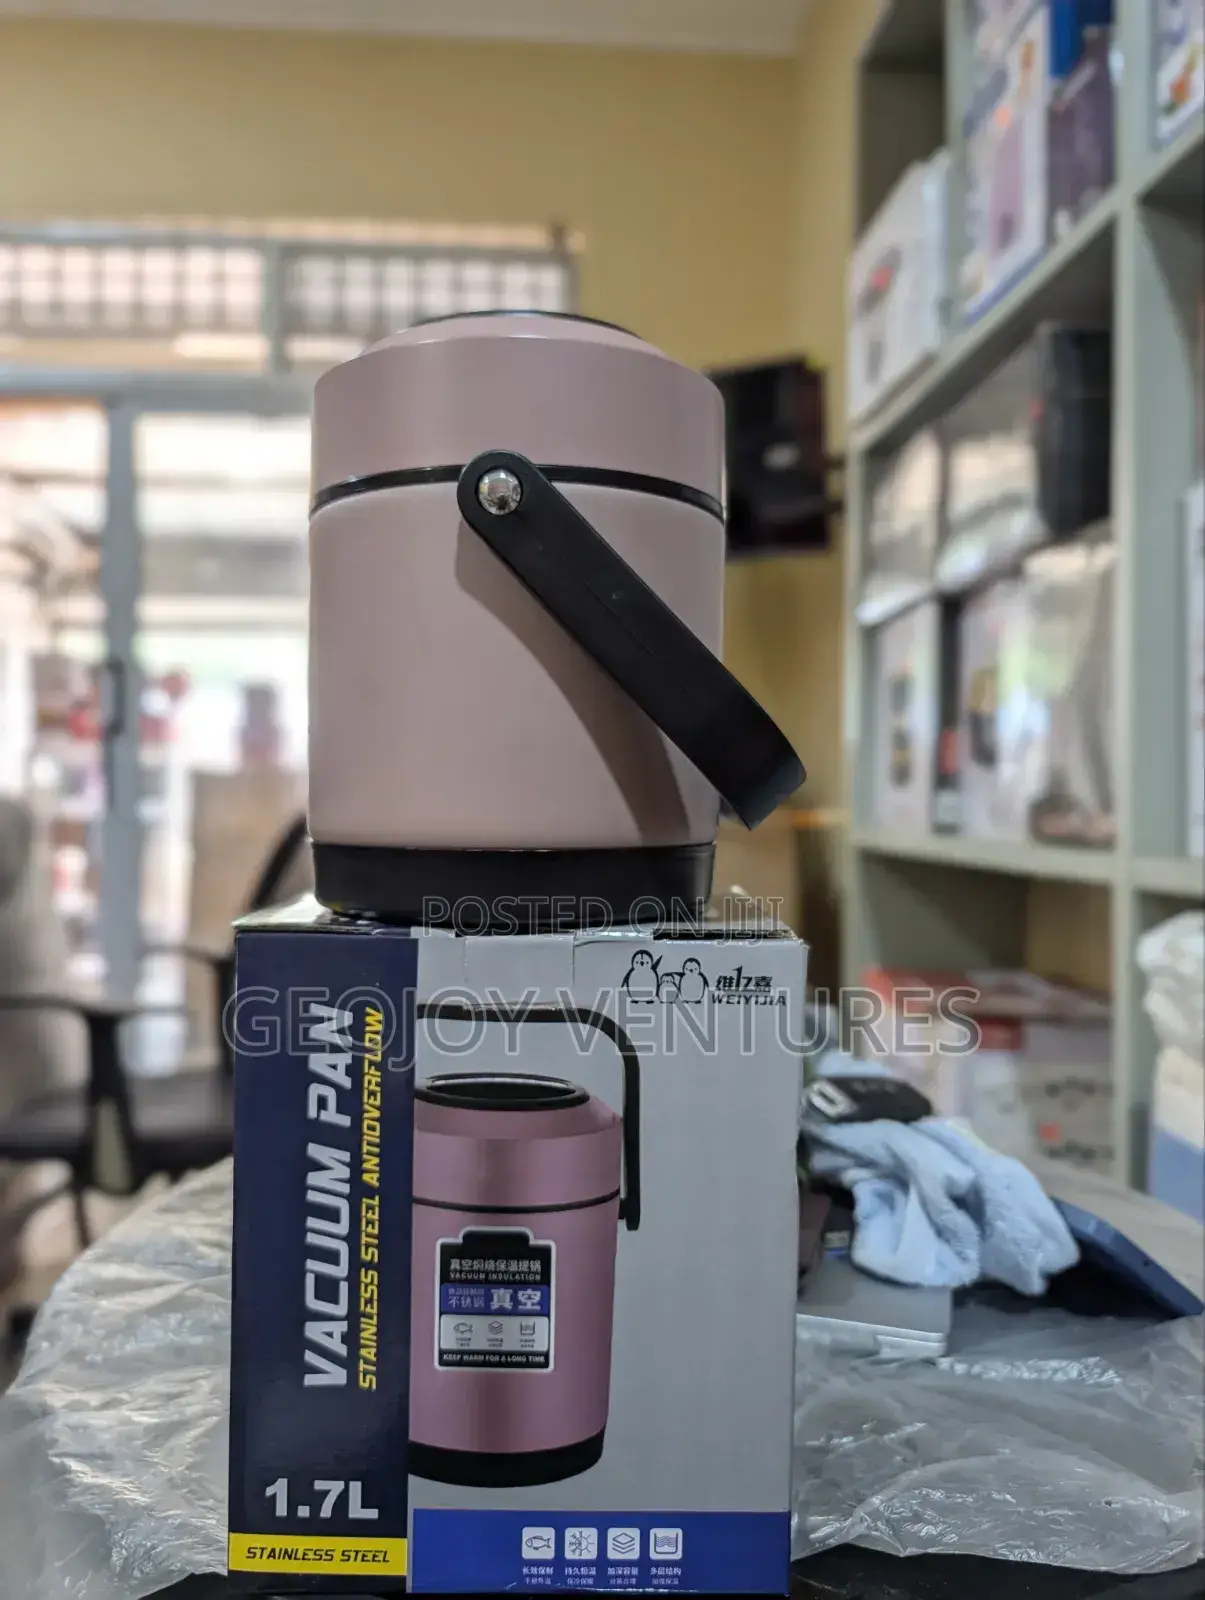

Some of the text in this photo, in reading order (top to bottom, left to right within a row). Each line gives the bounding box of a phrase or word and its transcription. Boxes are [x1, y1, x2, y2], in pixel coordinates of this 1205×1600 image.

[711, 993, 787, 1007] WEIYIJIA
[303, 1002, 354, 1387] VACUUM PAN
[358, 1006, 384, 1391] STAINLESS STEEL ANTIOVERFLOW
[450, 1271, 541, 1281] VACUUM INSULATION
[490, 1287, 542, 1311] 真空
[443, 1353, 461, 1361] KEEP
[462, 1353, 485, 1361] WARM
[507, 1355, 527, 1363] LONG
[528, 1355, 545, 1363] TIME
[264, 1477, 379, 1519] 1.7L
[246, 1546, 390, 1563] STAINLESS STEEL
[650, 1566, 682, 1576] 多层结构
